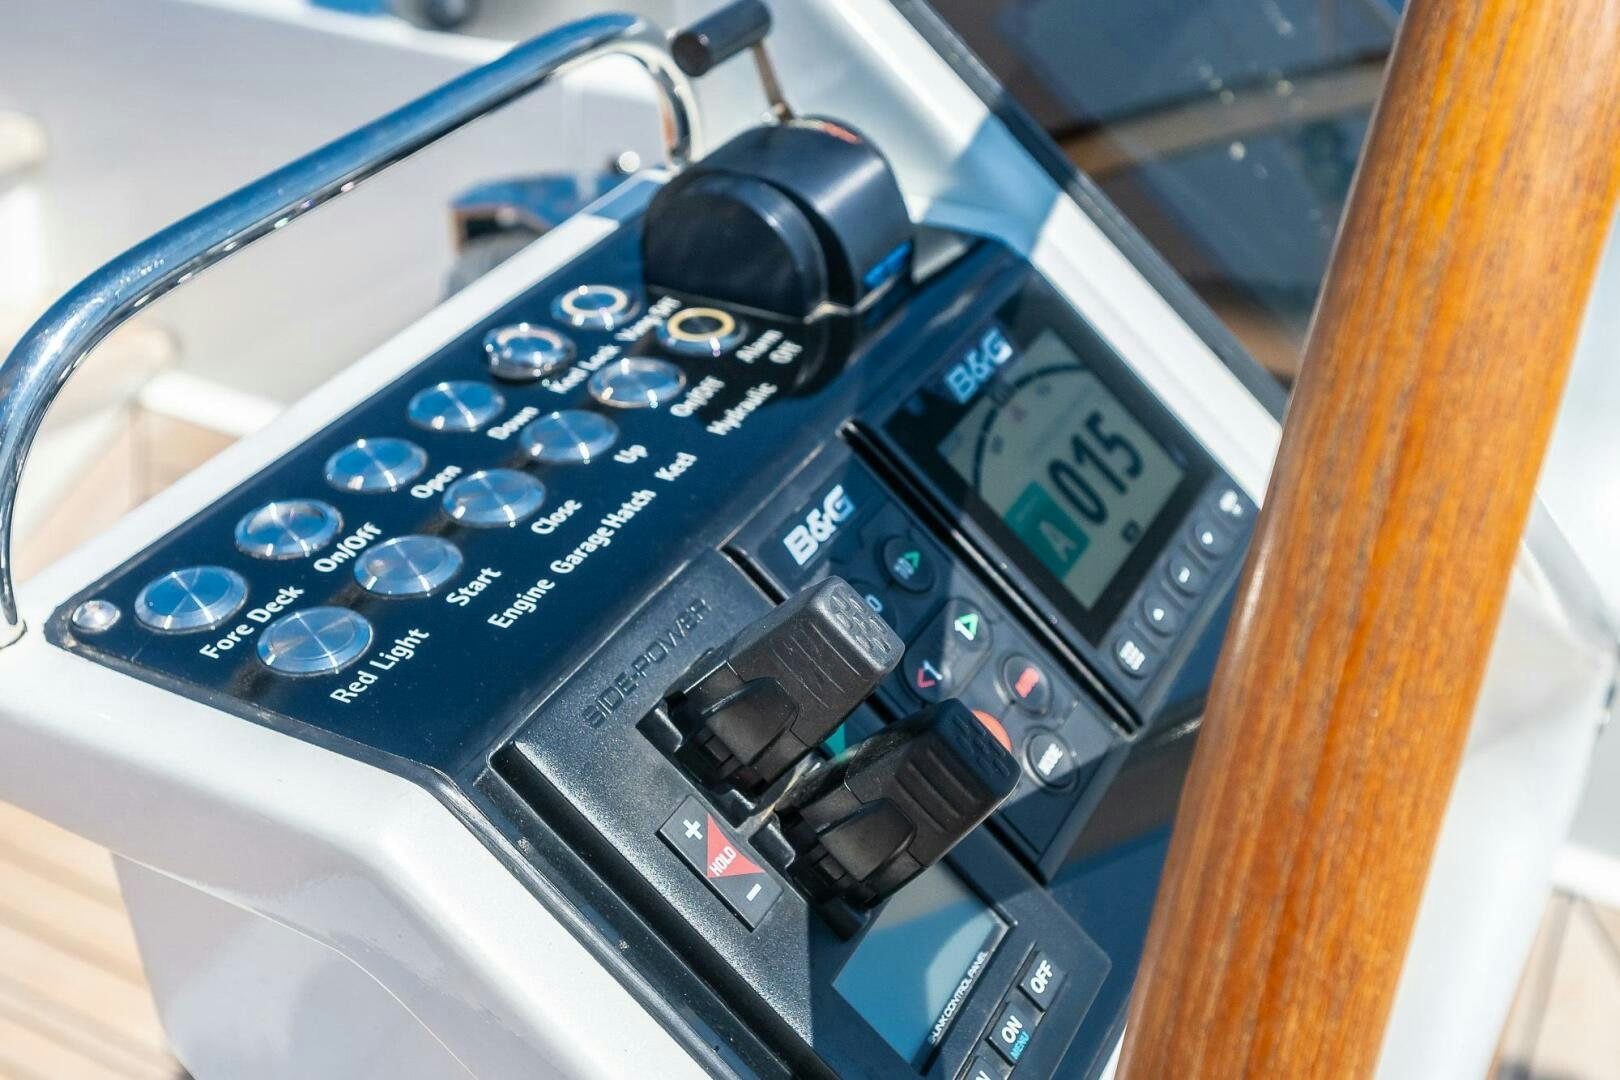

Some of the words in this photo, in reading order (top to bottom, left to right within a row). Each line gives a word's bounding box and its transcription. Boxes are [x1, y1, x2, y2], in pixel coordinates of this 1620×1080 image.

[944, 327, 1013, 404] B&G
[487, 406, 540, 440] Down
[706, 382, 778, 436] Hydraulic
[614, 444, 648, 464] Up
[654, 452, 697, 482] Keel
[1047, 411, 1144, 525] 015
[410, 465, 462, 498] Open
[531, 499, 583, 535] Close
[550, 524, 615, 574] Garage
[601, 489, 657, 528] Hatch
[783, 484, 855, 566] B&G
[313, 521, 383, 573] On/Off
[1039, 521, 1076, 562] A
[446, 567, 502, 606] Start
[487, 577, 556, 629] Engine
[199, 621, 255, 660] Fore
[246, 585, 305, 624] Deck
[329, 671, 378, 704] Red
[373, 627, 430, 671] Light
[582, 598, 713, 729] SIDE-POWER
[708, 845, 737, 877] HOLD
[943, 977, 972, 1018] CONTROL
[967, 953, 989, 981] PANEL
[1030, 959, 1053, 994] OFF
[1001, 1015, 1023, 1044] ON
[1008, 1033, 1030, 1061] MENU
